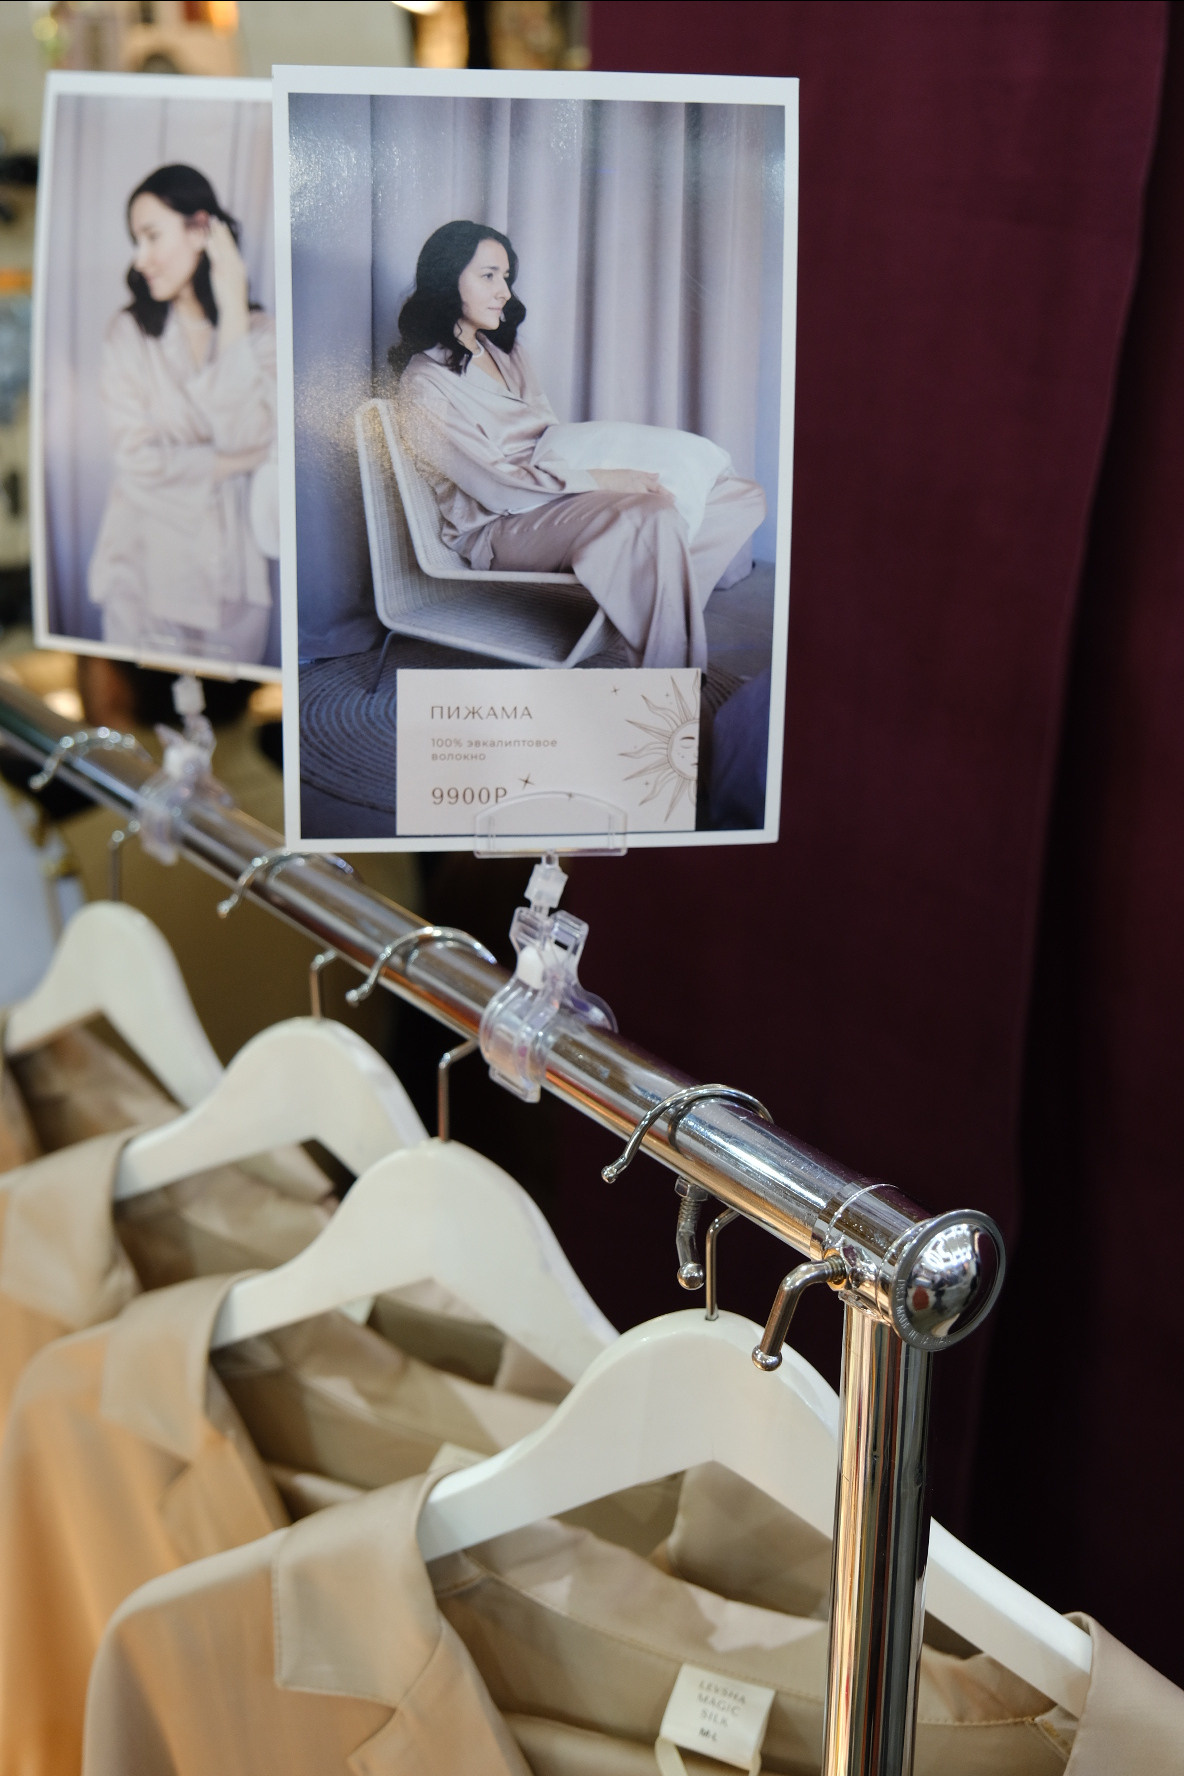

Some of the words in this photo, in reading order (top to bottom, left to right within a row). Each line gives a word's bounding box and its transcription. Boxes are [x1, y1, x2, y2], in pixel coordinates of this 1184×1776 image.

[430, 705, 533, 720] ПИЖАМА
[431, 738, 463, 748] 100%
[467, 738, 557, 748] эвкалиптовое
[431, 752, 486, 761] волокно
[697, 1692, 741, 1717] MAGIC
[701, 1709, 728, 1727] SILK
